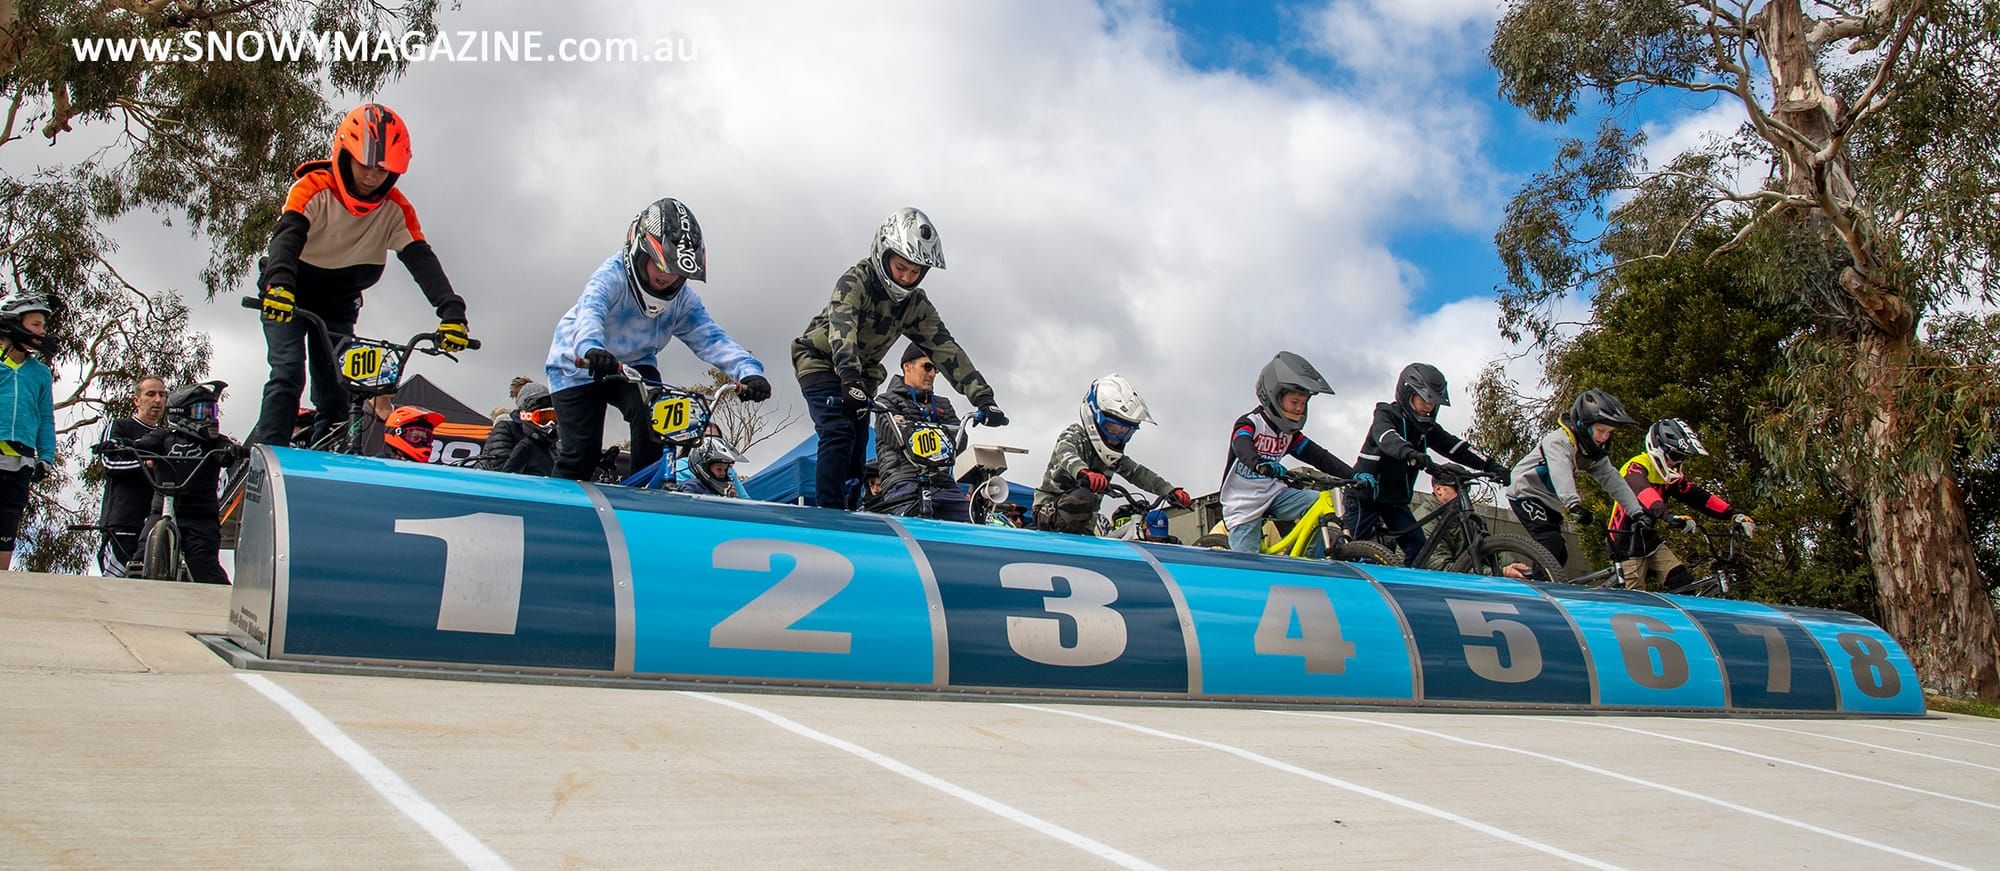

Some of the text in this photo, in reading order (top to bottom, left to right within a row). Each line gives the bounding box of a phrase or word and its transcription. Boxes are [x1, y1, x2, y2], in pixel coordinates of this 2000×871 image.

[351, 350, 376, 377] 610
[663, 402, 684, 430] 76
[918, 432, 937, 454] 106
[394, 512, 524, 635] 1
[710, 539, 854, 654] 2
[999, 561, 1129, 668] 3
[1254, 585, 1355, 675] 4
[1445, 598, 1543, 683] 5
[1610, 614, 1689, 689] 6
[1735, 623, 1792, 694] 7
[1837, 633, 1901, 698] 8
